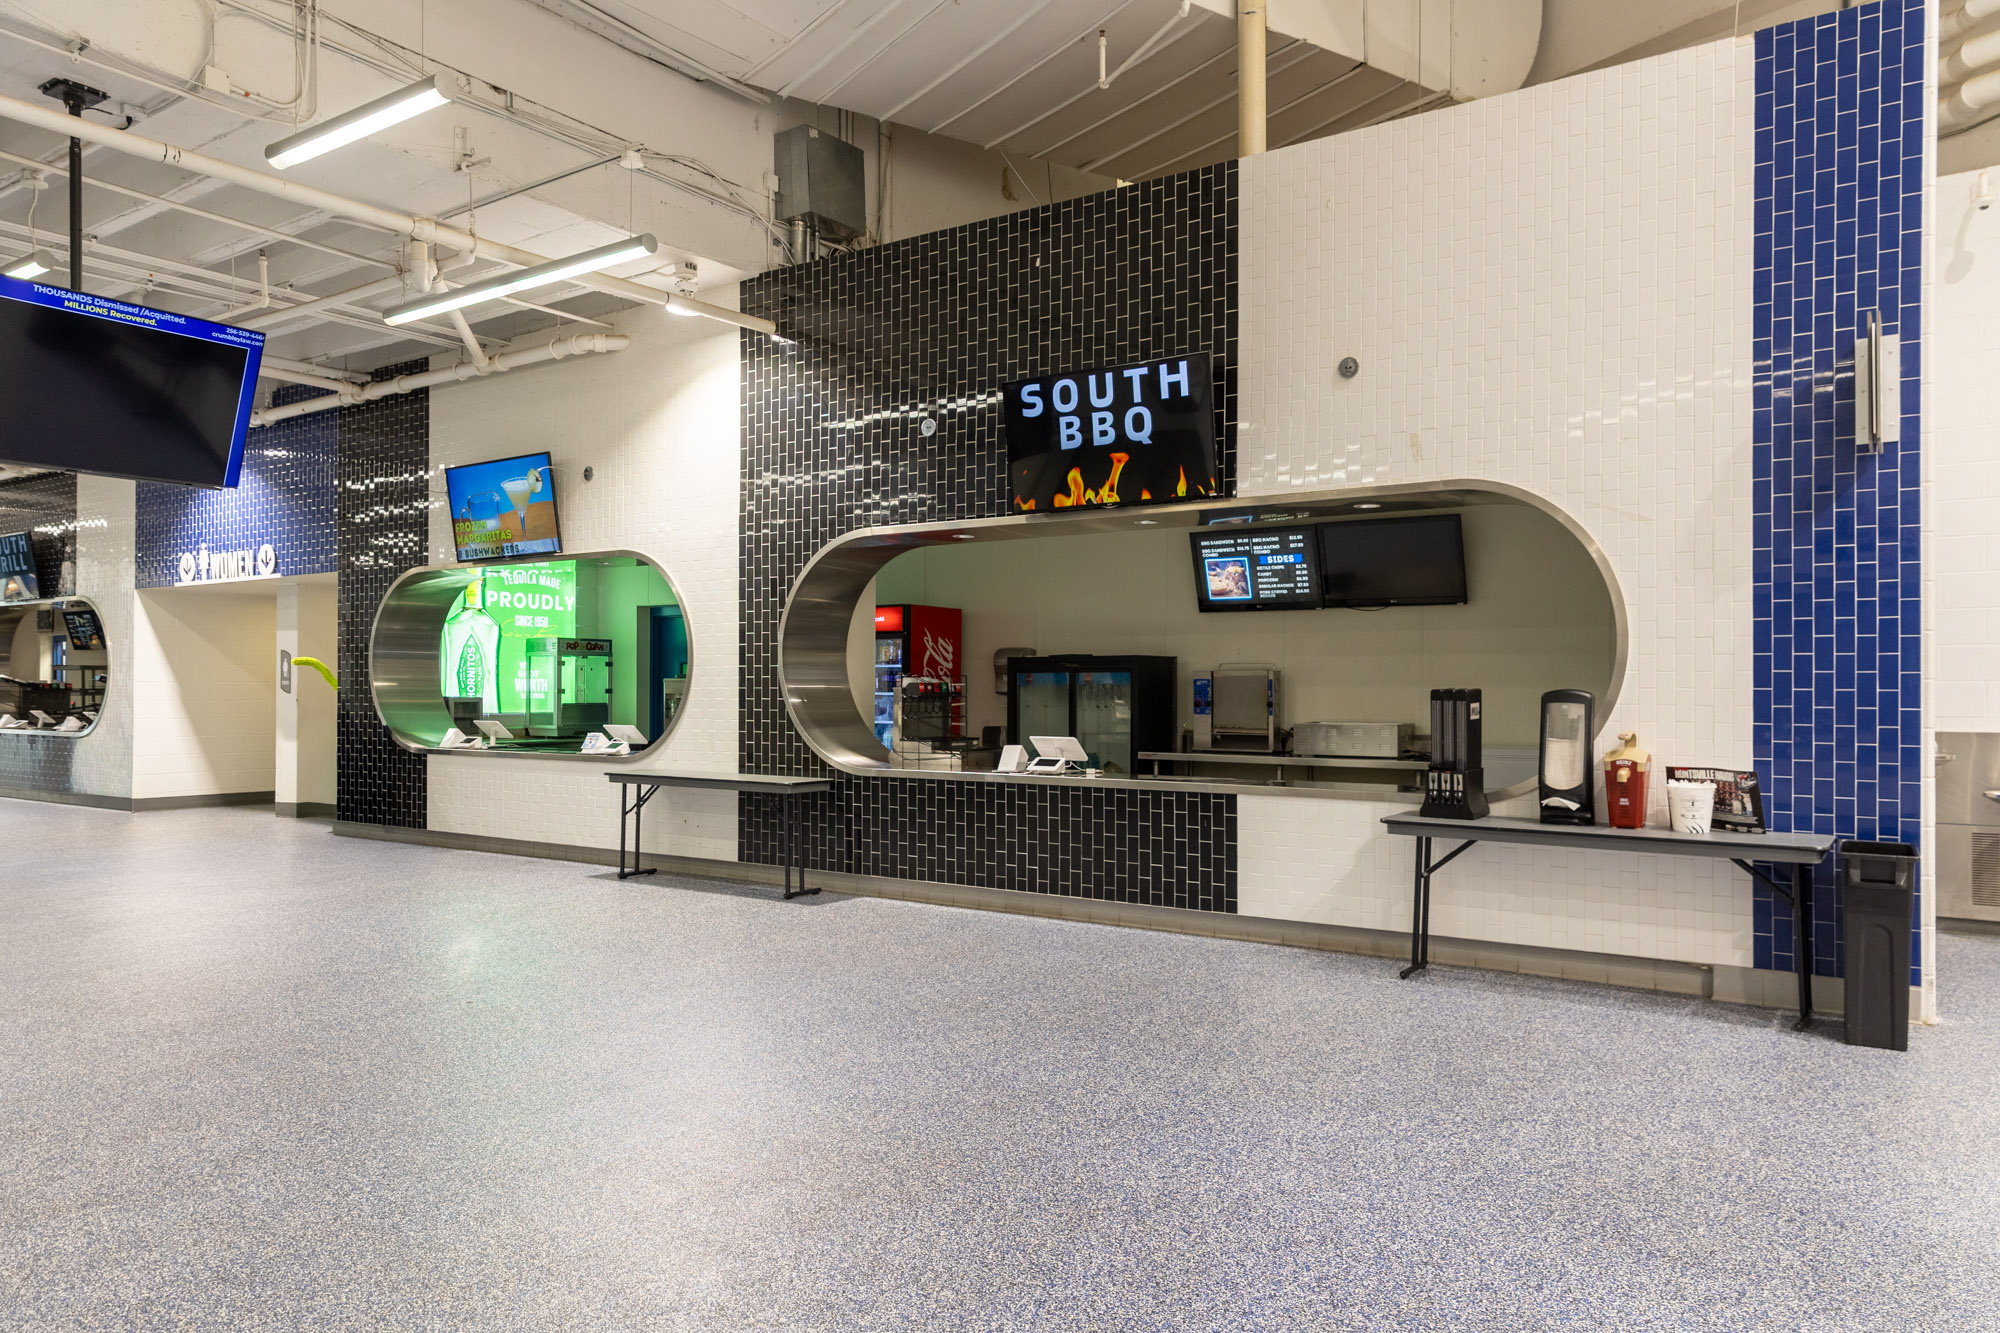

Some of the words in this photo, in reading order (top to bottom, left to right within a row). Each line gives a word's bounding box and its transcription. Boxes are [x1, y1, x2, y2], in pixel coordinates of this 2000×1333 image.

[33, 284, 92, 304] THOUSANDS
[94, 297, 139, 314] Dismissed
[139, 307, 186, 324] /Acquitted.
[64, 300, 108, 315] MILLIONS
[110, 310, 157, 326] Recovered.
[1020, 360, 1190, 418] SOUTH
[1059, 405, 1153, 450] BBQ
[455, 520, 487, 533] FROZEN
[456, 529, 512, 544] MARGARITAS
[465, 544, 520, 558] BUSHWACKERS
[1267, 555, 1294, 563] SIDES
[0, 554, 28, 573] RILL
[210, 550, 254, 579] WOMEN
[503, 573, 537, 586] TEQUILA
[538, 575, 562, 590] MADE
[486, 590, 576, 612] PROUDLY
[514, 614, 533, 627] SINCE
[566, 641, 579, 650] POP
[467, 646, 476, 698] HORNITOS
[1674, 769, 1715, 780] HUNTSVILLE
